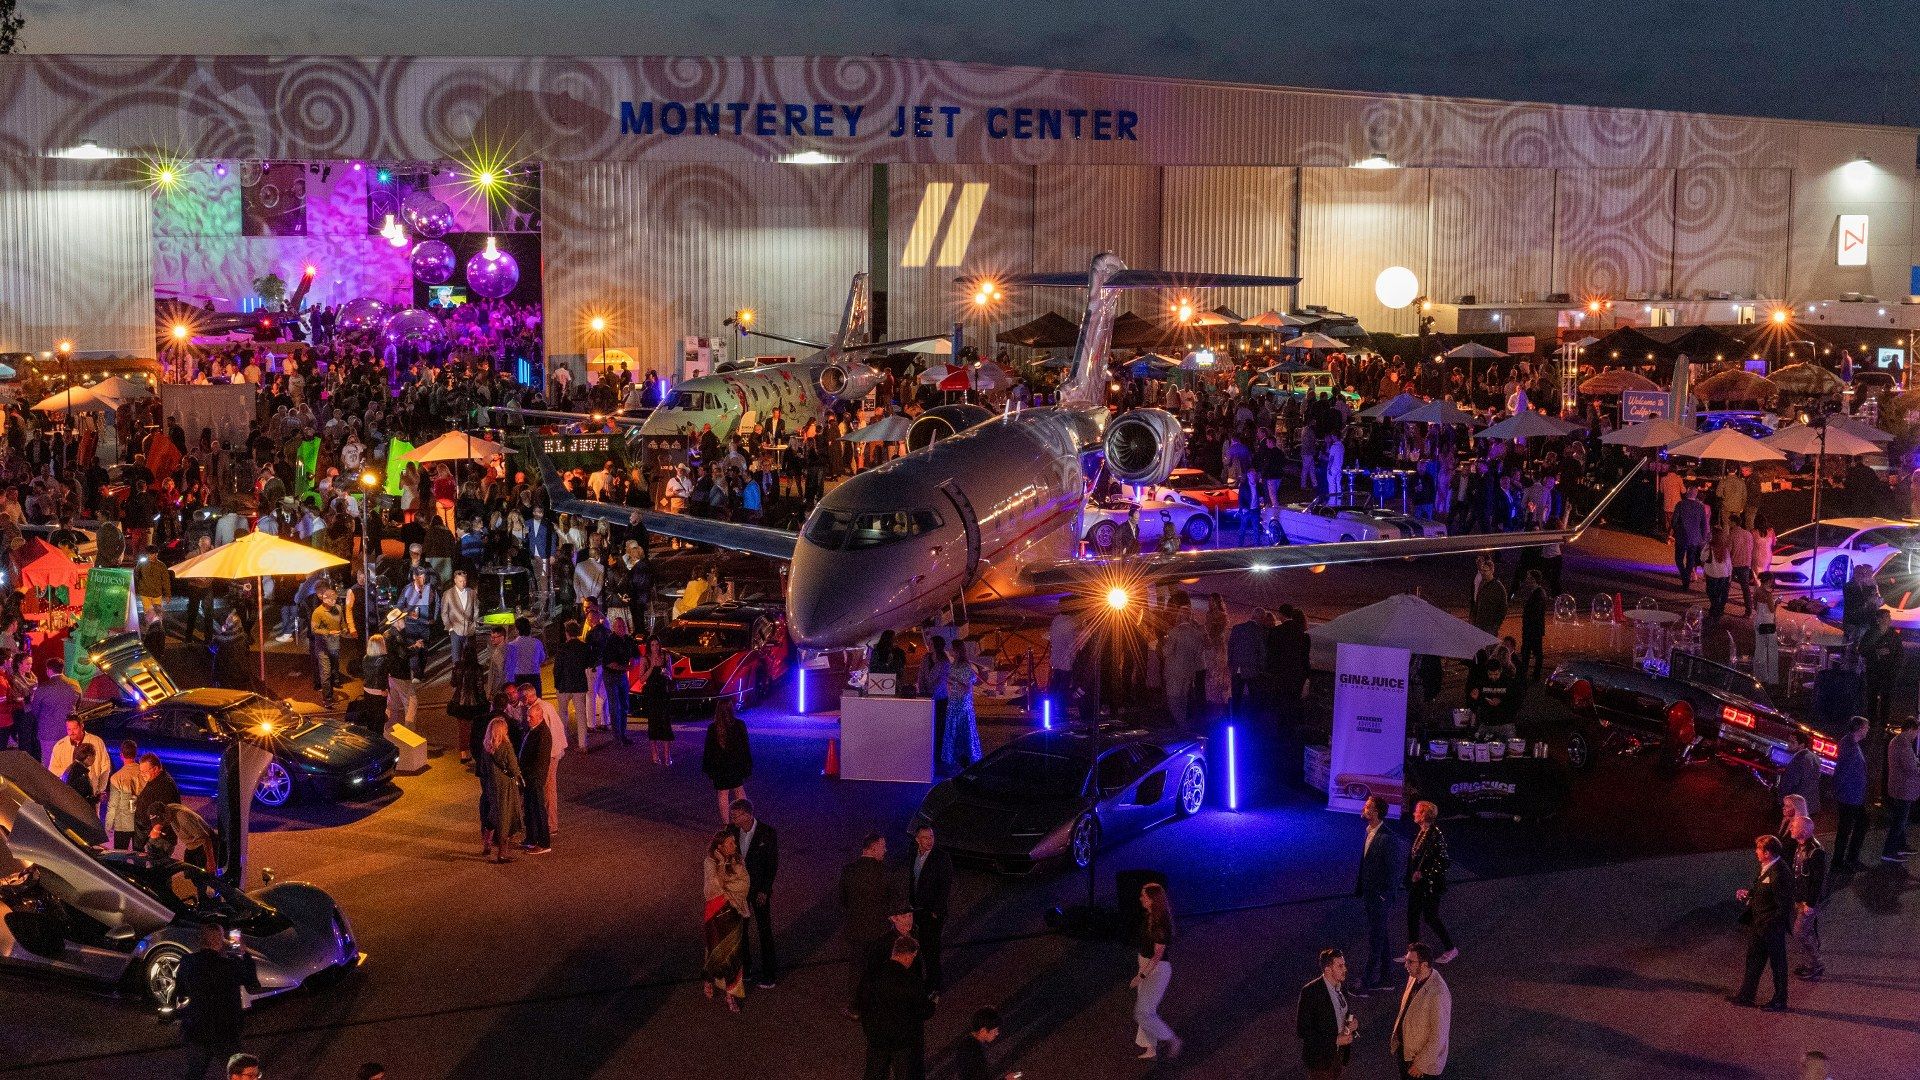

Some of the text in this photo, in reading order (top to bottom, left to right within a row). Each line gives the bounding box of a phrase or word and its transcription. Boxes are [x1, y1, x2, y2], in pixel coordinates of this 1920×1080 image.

[620, 101, 1139, 141] MONTEREY JET CENTER
[1628, 396, 1656, 406] Welcome
[544, 438, 609, 453] EL JEFE
[90, 571, 126, 586] Hennessy
[869, 678, 896, 692] XO
[1340, 673, 1405, 689] GIN&JUICE
